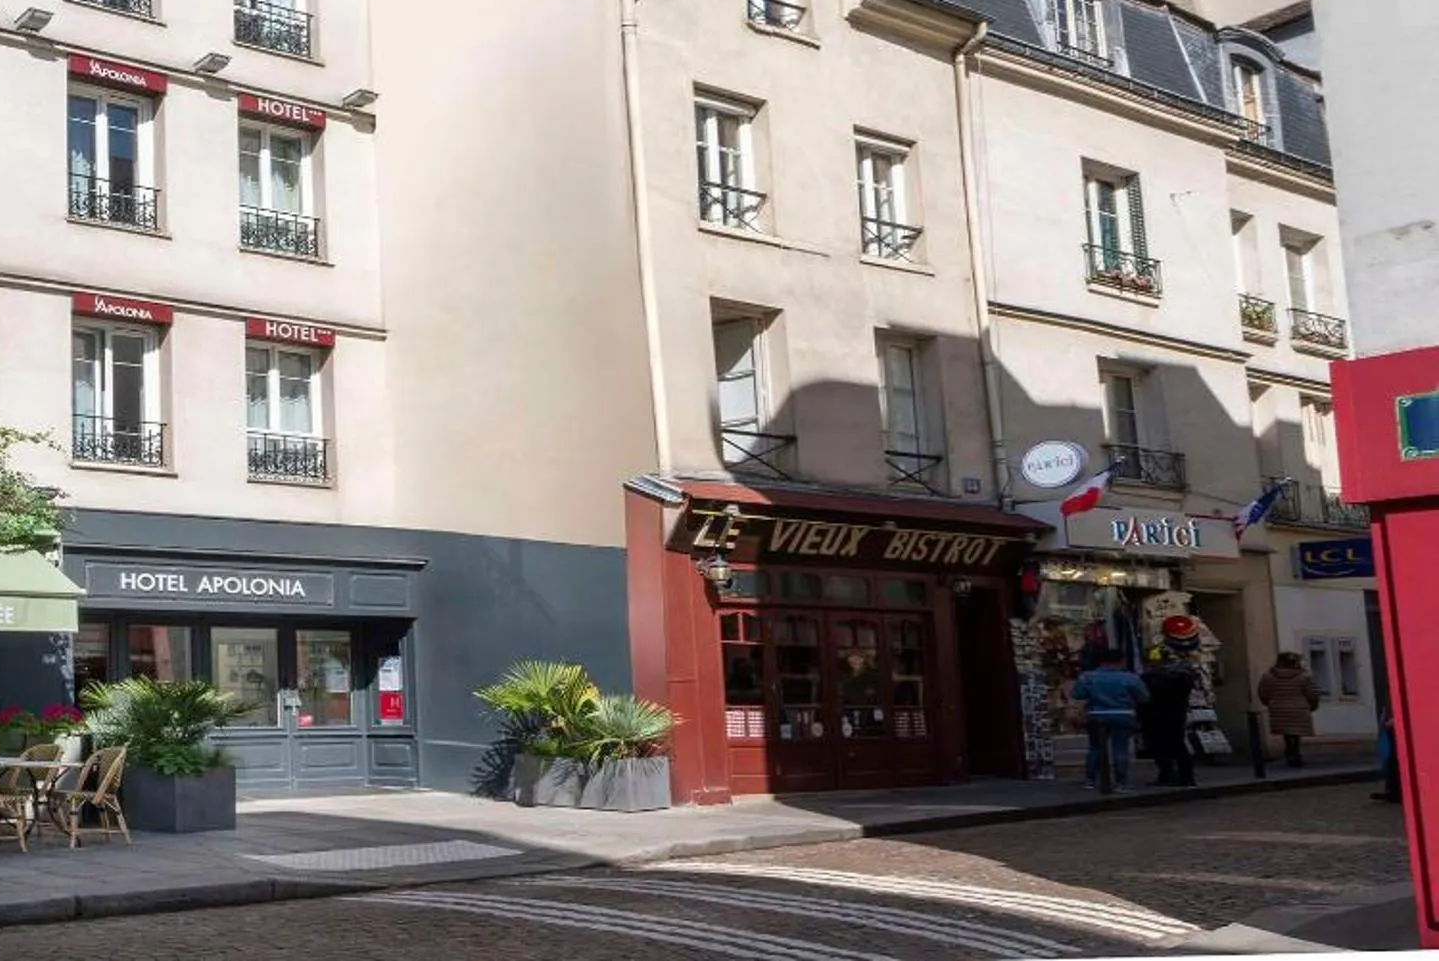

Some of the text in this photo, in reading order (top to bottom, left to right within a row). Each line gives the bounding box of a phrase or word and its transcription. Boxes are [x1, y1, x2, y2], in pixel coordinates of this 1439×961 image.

[258, 98, 309, 121] HOTEL
[266, 321, 318, 342] HOTEL
[769, 517, 870, 556] VIEUX
[883, 530, 1007, 565] BISTROT
[1305, 547, 1363, 563] LCL
[120, 572, 306, 597] HOTEL APOLONIA
